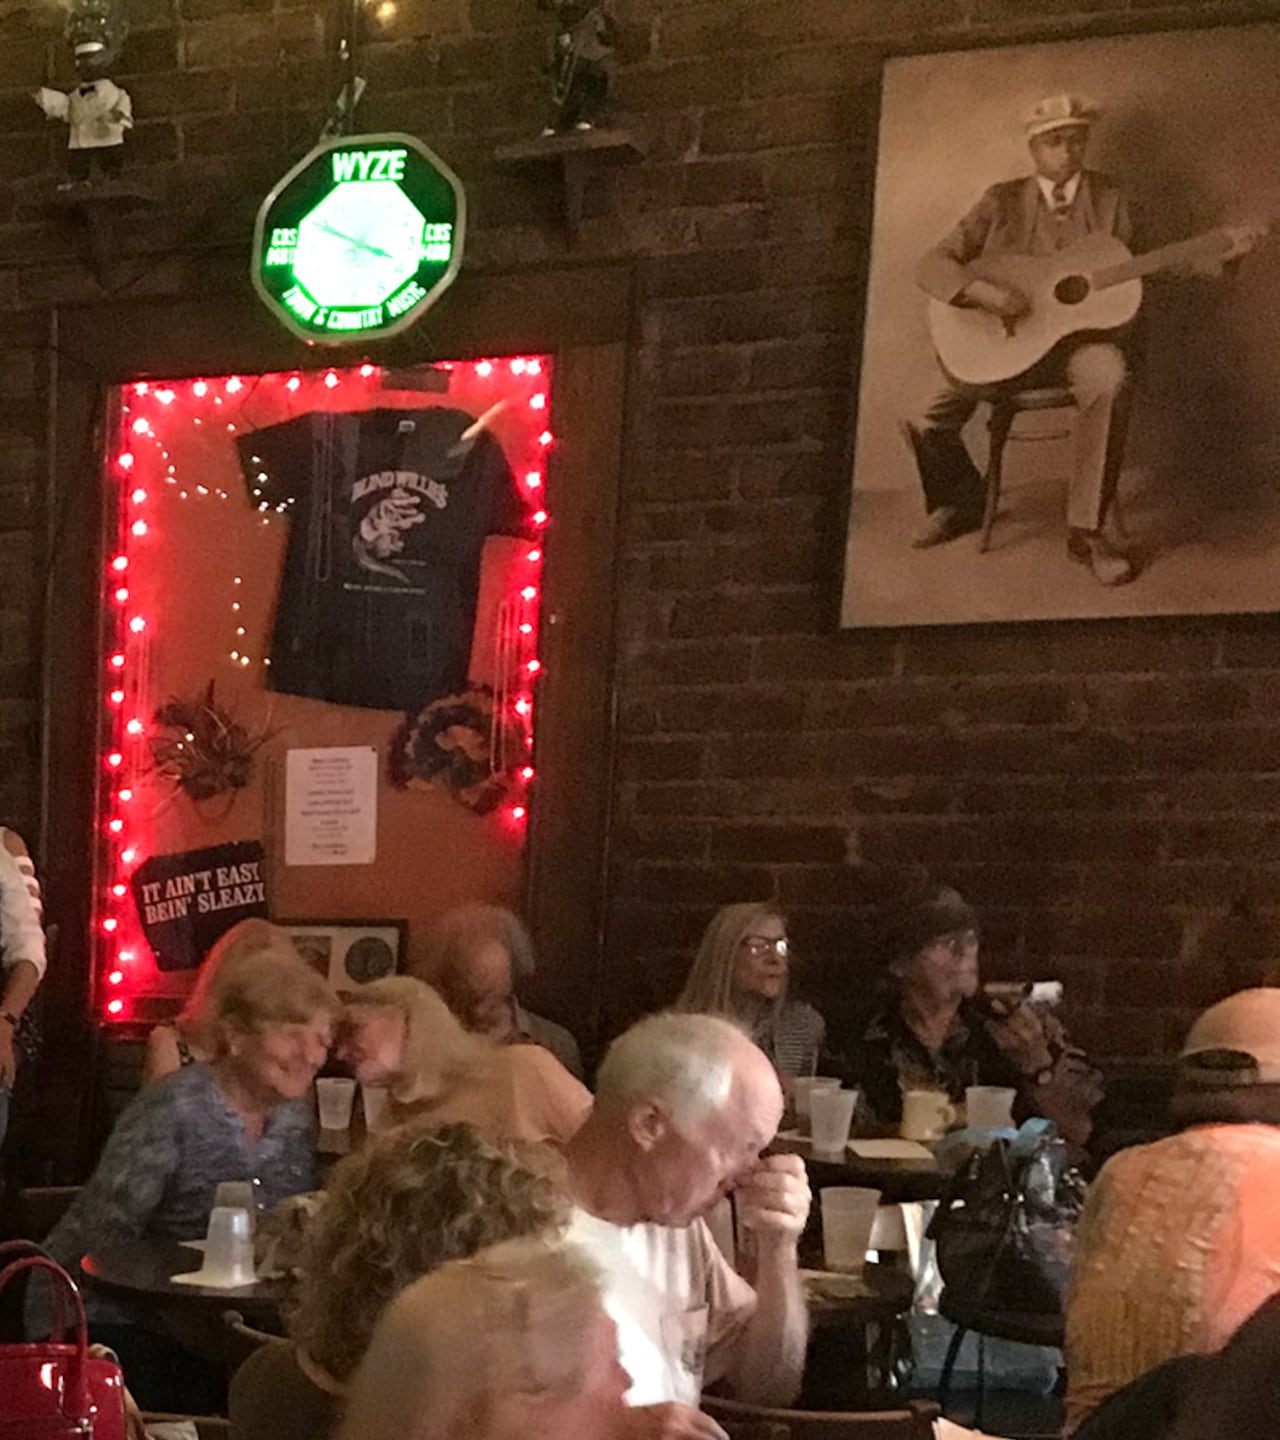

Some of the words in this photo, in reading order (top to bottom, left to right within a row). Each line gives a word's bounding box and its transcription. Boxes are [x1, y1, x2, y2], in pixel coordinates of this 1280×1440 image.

[332, 150, 407, 182] WYZE
[142, 882, 160, 903] IT
[165, 871, 212, 899] AIN'T
[216, 862, 260, 887] EASY
[145, 896, 192, 925] BEIN'
[197, 882, 265, 913] SLEAZY
